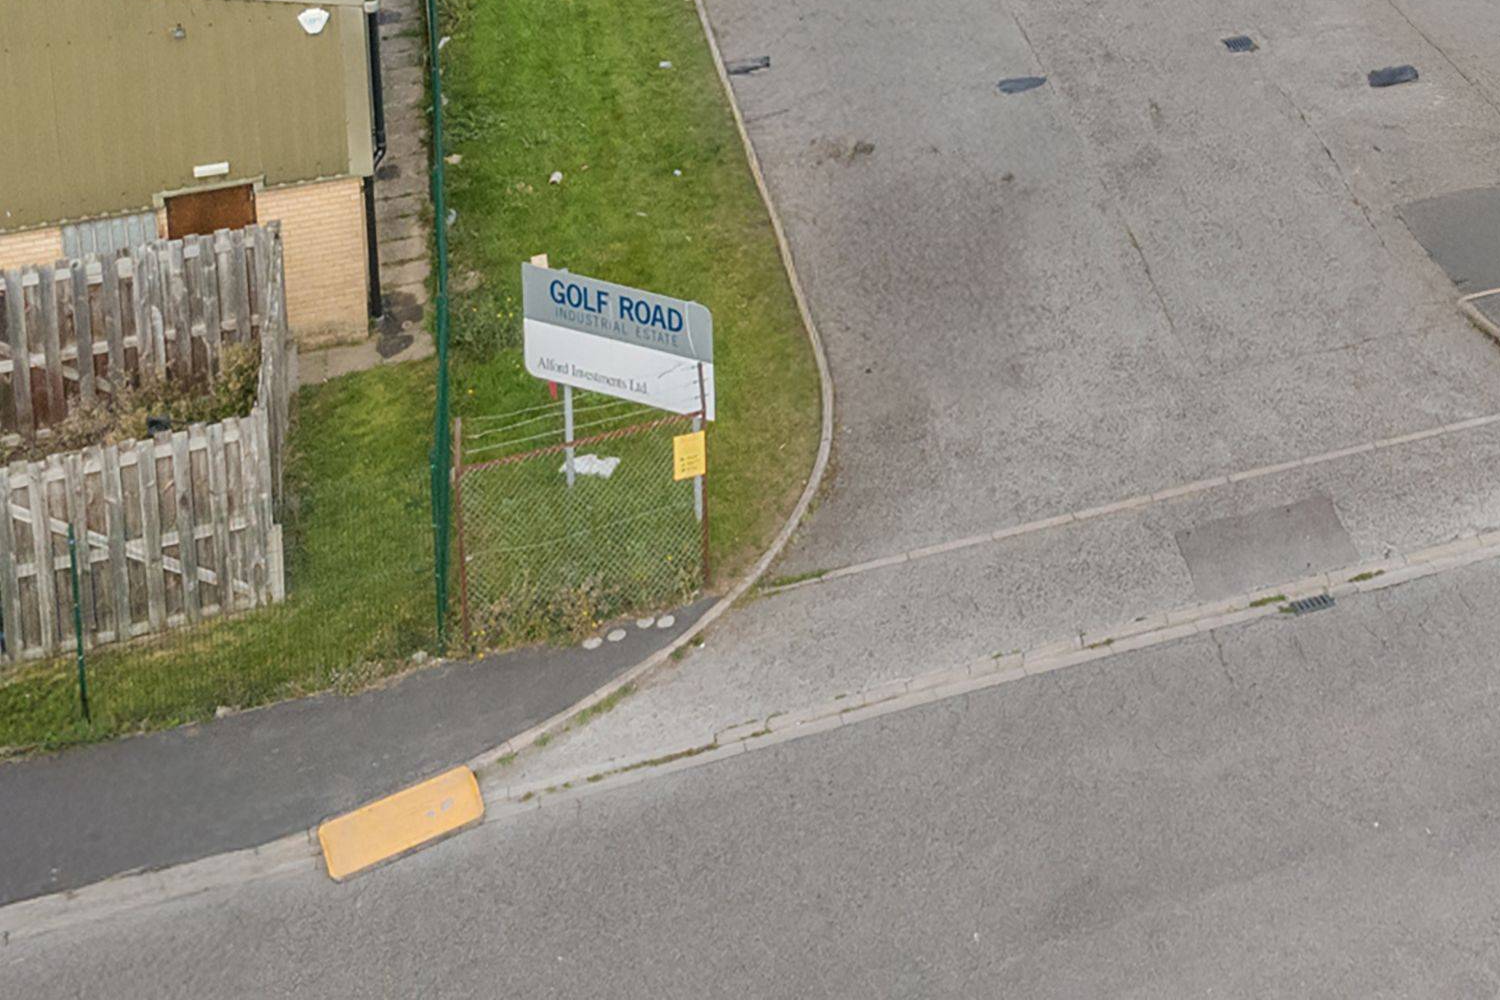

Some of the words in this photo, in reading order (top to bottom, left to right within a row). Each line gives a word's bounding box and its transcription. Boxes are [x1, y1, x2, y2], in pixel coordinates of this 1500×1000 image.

[550, 279, 610, 314] GOLF
[619, 295, 684, 332] ROAD
[555, 307, 628, 335] INDUSTRIAL
[635, 326, 679, 348] ESTATE
[538, 357, 569, 376] Alford
[571, 364, 628, 390] Investments
